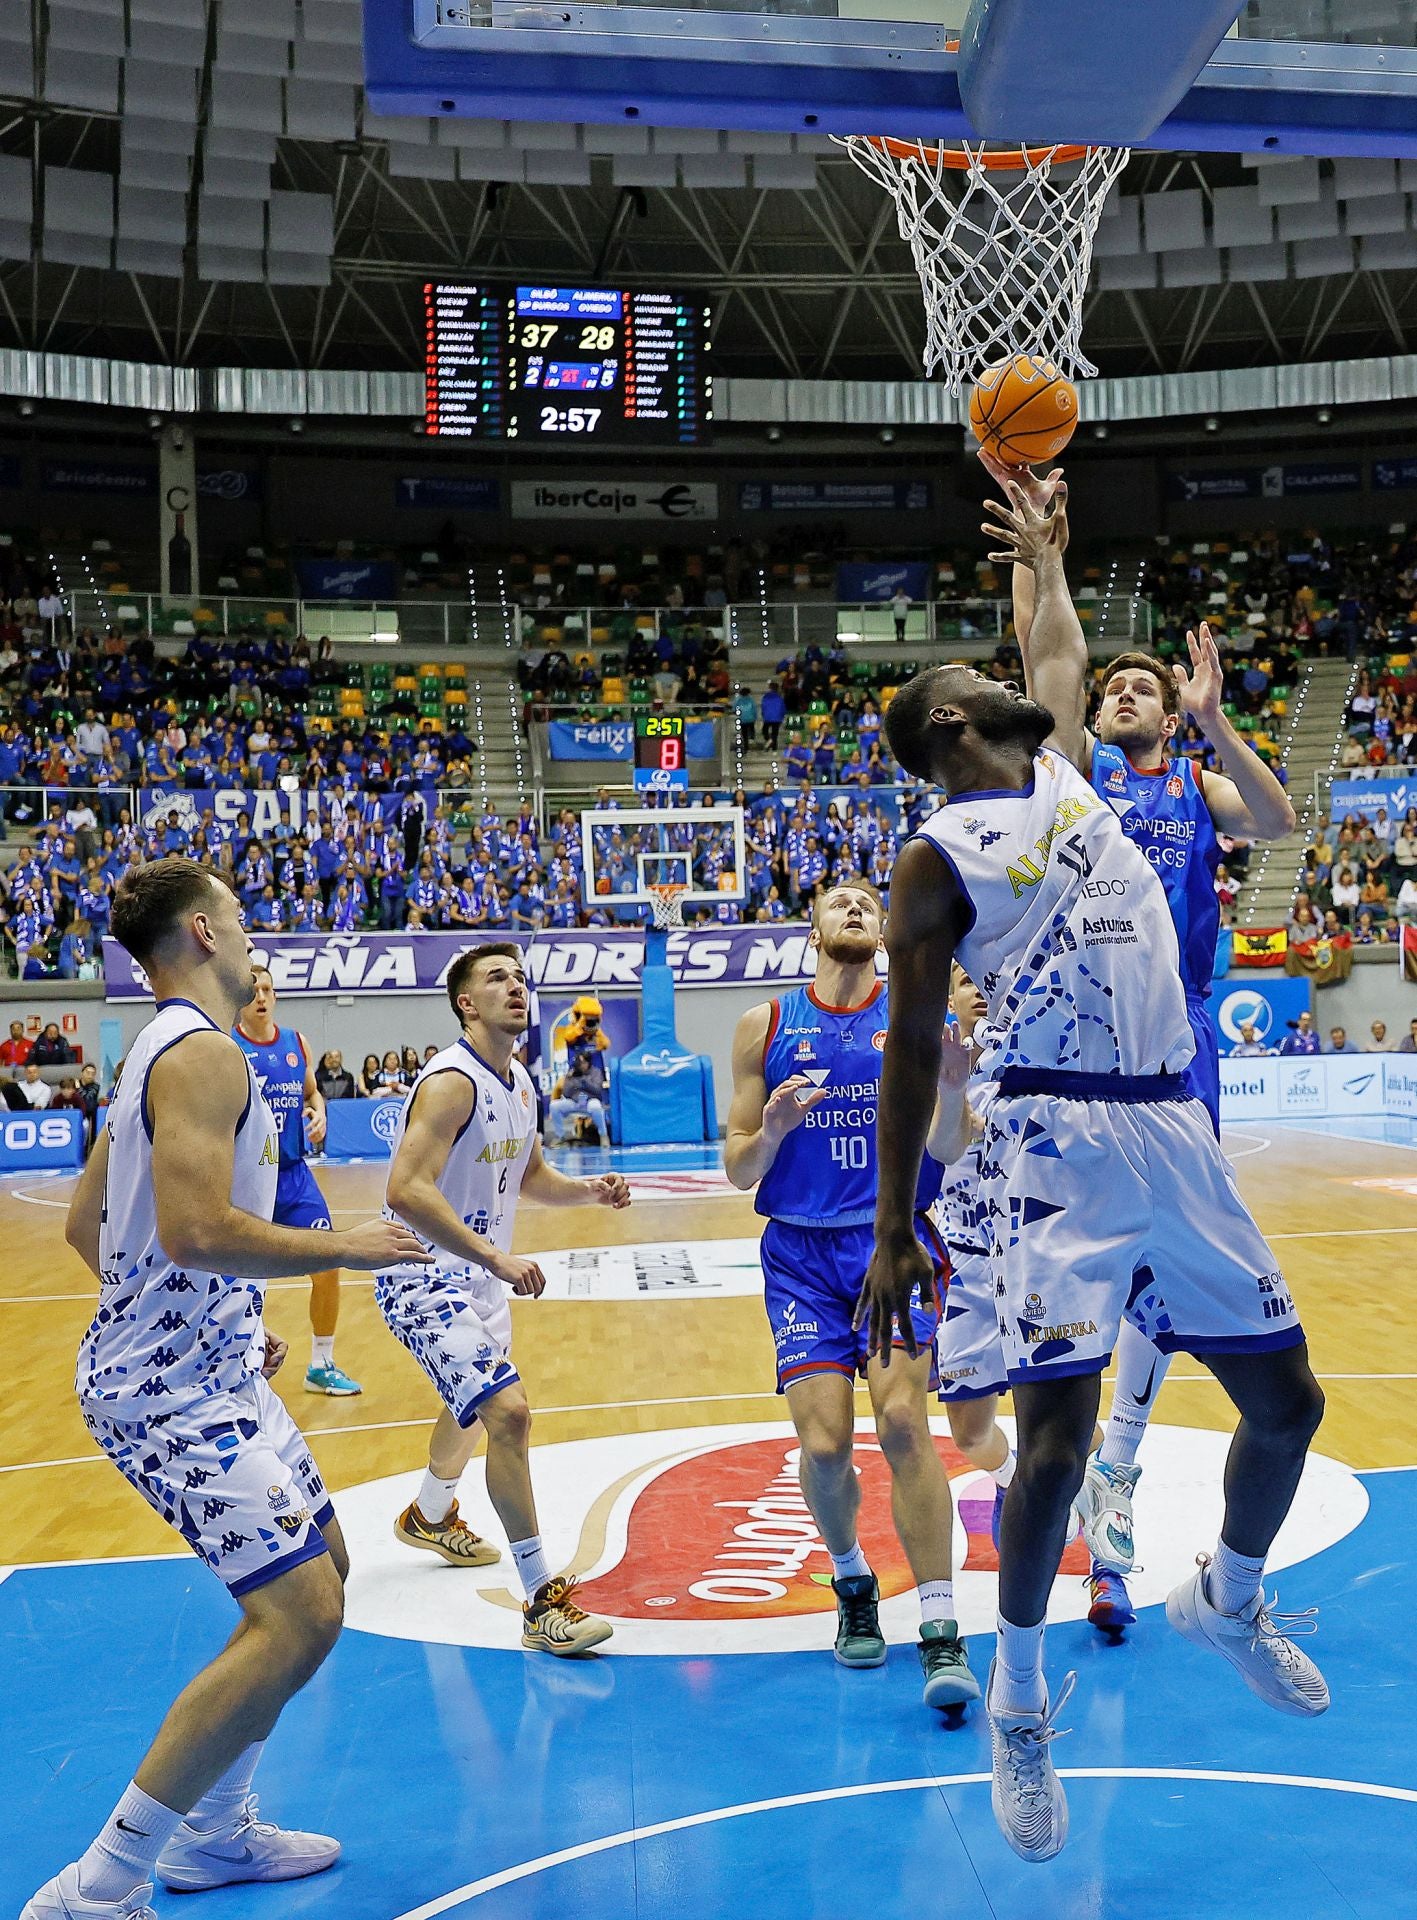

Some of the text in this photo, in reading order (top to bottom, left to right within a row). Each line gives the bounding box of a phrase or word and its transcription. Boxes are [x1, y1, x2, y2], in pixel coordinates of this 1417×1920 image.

[518, 300, 570, 311] SP BURGOS
[572, 291, 617, 302] ALIMERKA
[578, 303, 613, 314] OVIEDO
[521, 324, 559, 348] 37
[579, 325, 615, 350] 28
[525, 367, 540, 385] 2
[600, 370, 615, 387] 5
[540, 406, 601, 432] 2:57
[534, 488, 636, 513] iberCaja
[646, 717, 683, 736] 2:57
[660, 738, 679, 770] 8
[637, 782, 684, 792] LEXUS
[1136, 844, 1186, 868] GOS
[1082, 879, 1126, 899] IEDO
[784, 1027, 822, 1035] GIVOVA
[274, 1112, 287, 1133] 3
[0, 1117, 71, 1150] OS
[829, 1135, 867, 1170] 40
[498, 1167, 508, 1194] 6
[1023, 1306, 1047, 1318] OVIEDO
[1027, 1320, 1098, 1344] ALIMERKA
